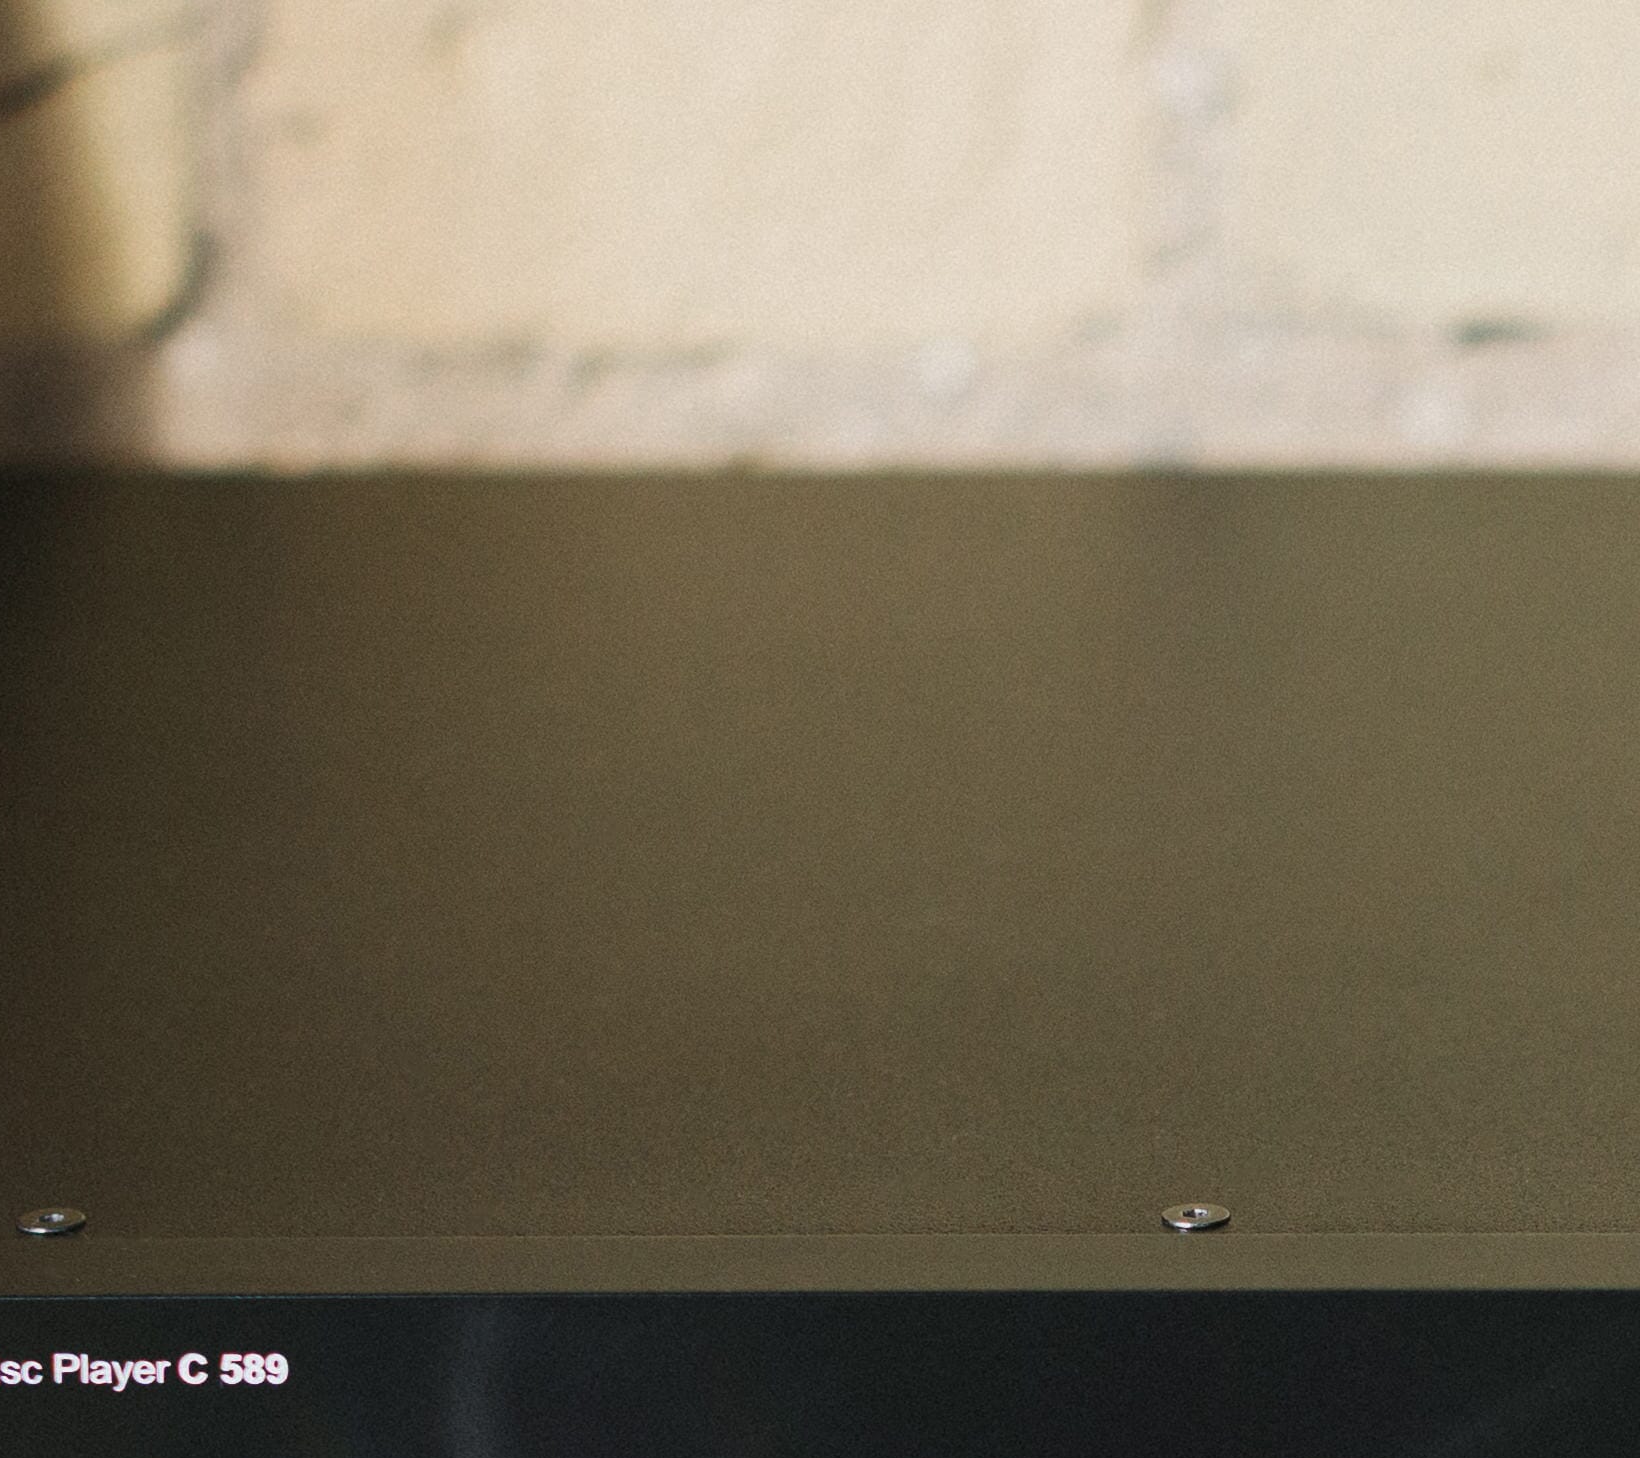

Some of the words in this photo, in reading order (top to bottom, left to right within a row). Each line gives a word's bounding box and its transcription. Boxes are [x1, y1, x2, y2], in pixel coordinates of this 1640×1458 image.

[53, 1353, 171, 1392] Player
[178, 1353, 208, 1385] C
[220, 1353, 288, 1385] 589
